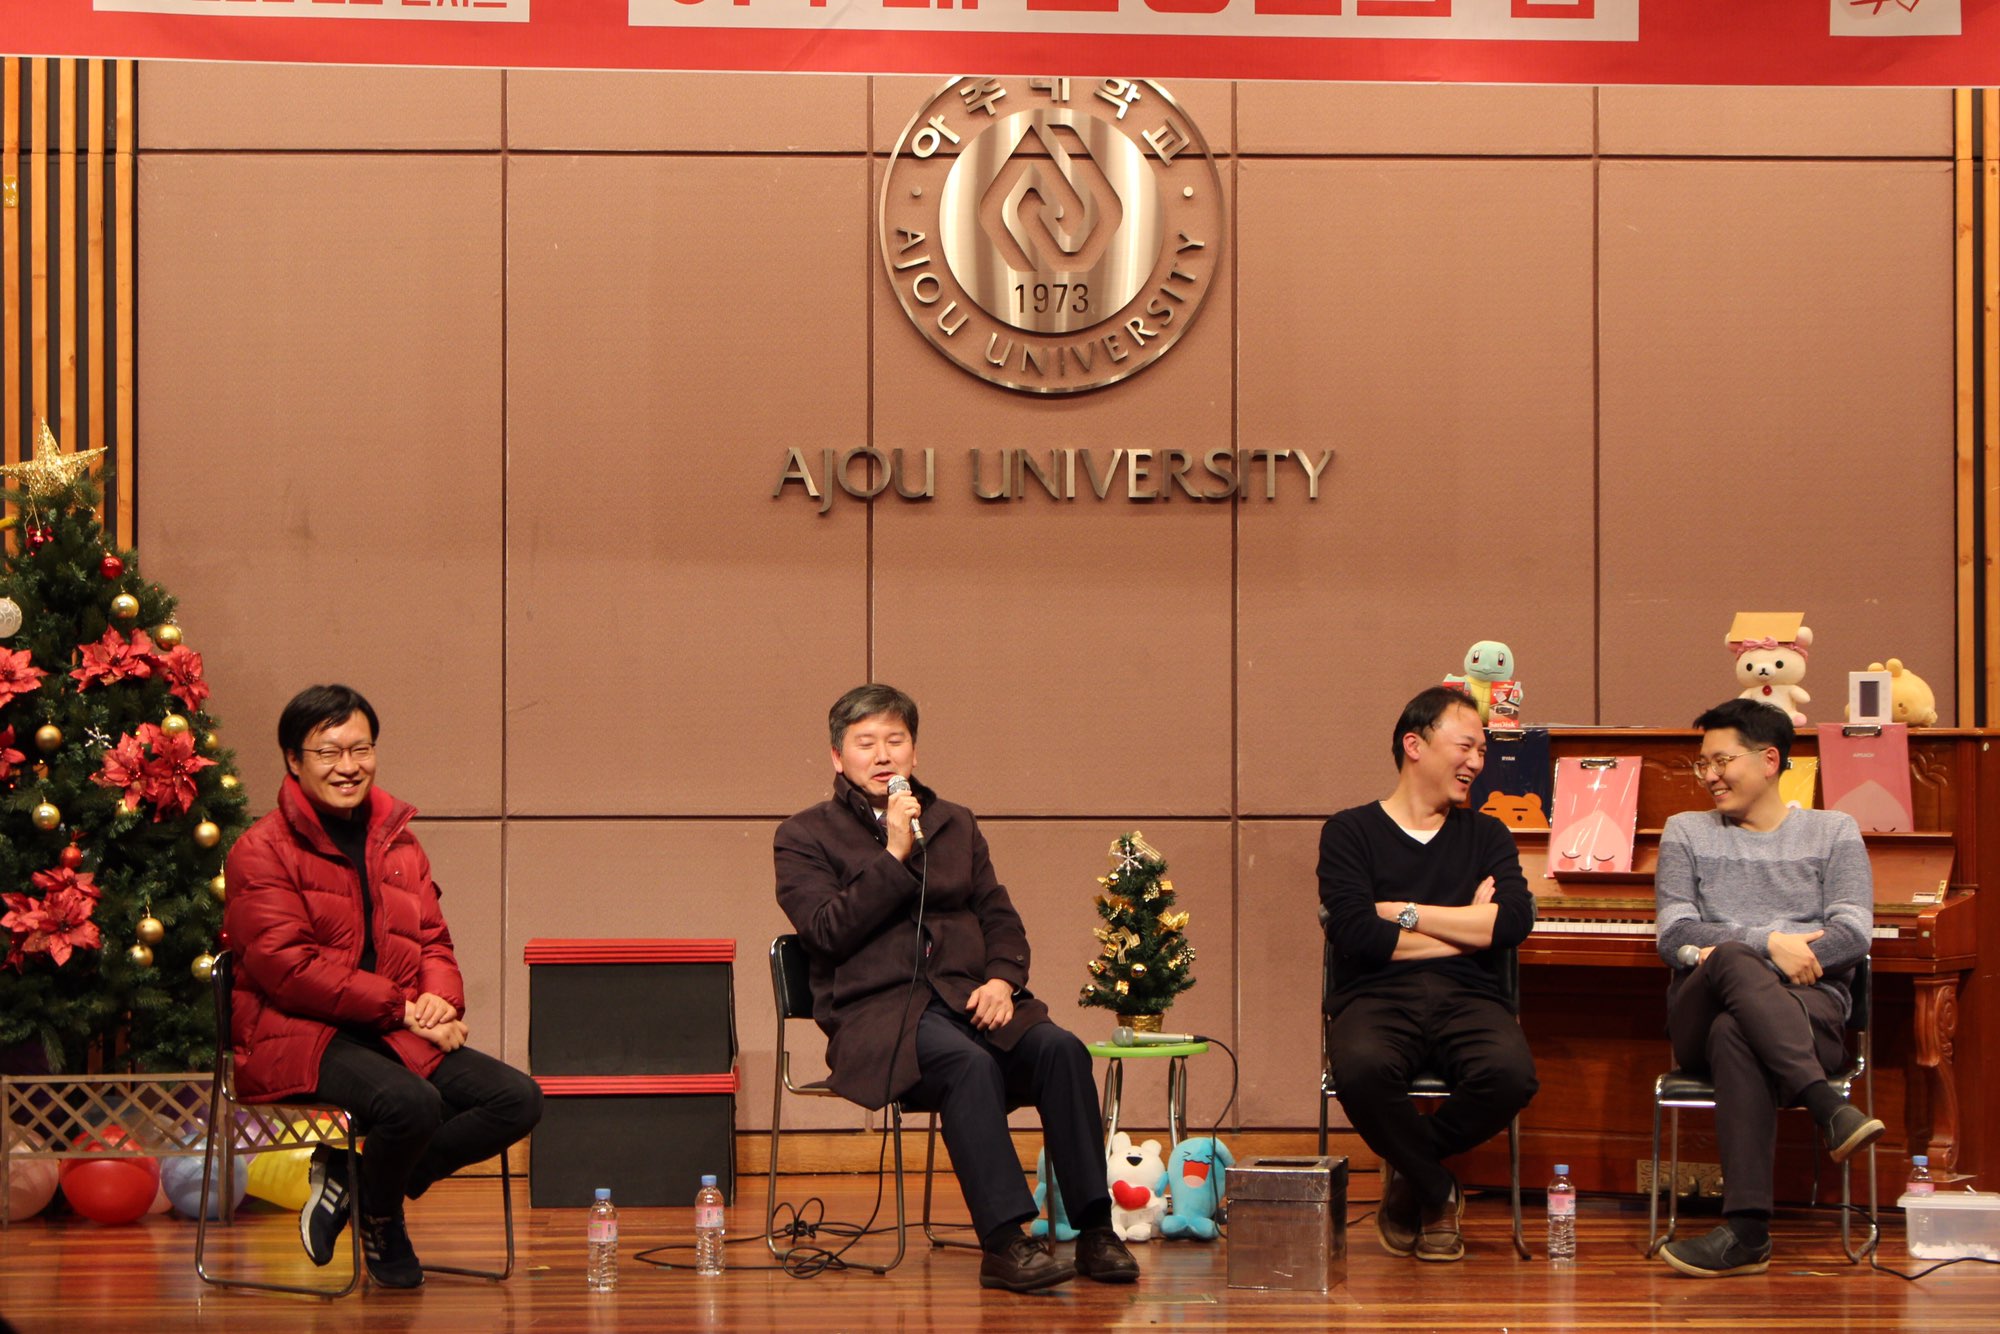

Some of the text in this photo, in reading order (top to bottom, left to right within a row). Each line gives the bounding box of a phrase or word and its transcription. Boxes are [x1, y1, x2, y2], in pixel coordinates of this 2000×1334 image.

[894, 226, 1206, 377] AJOU UNIVERSITY
[1014, 283, 1090, 314] 1973
[773, 446, 1335, 515] AJOU UNIVERSITY
